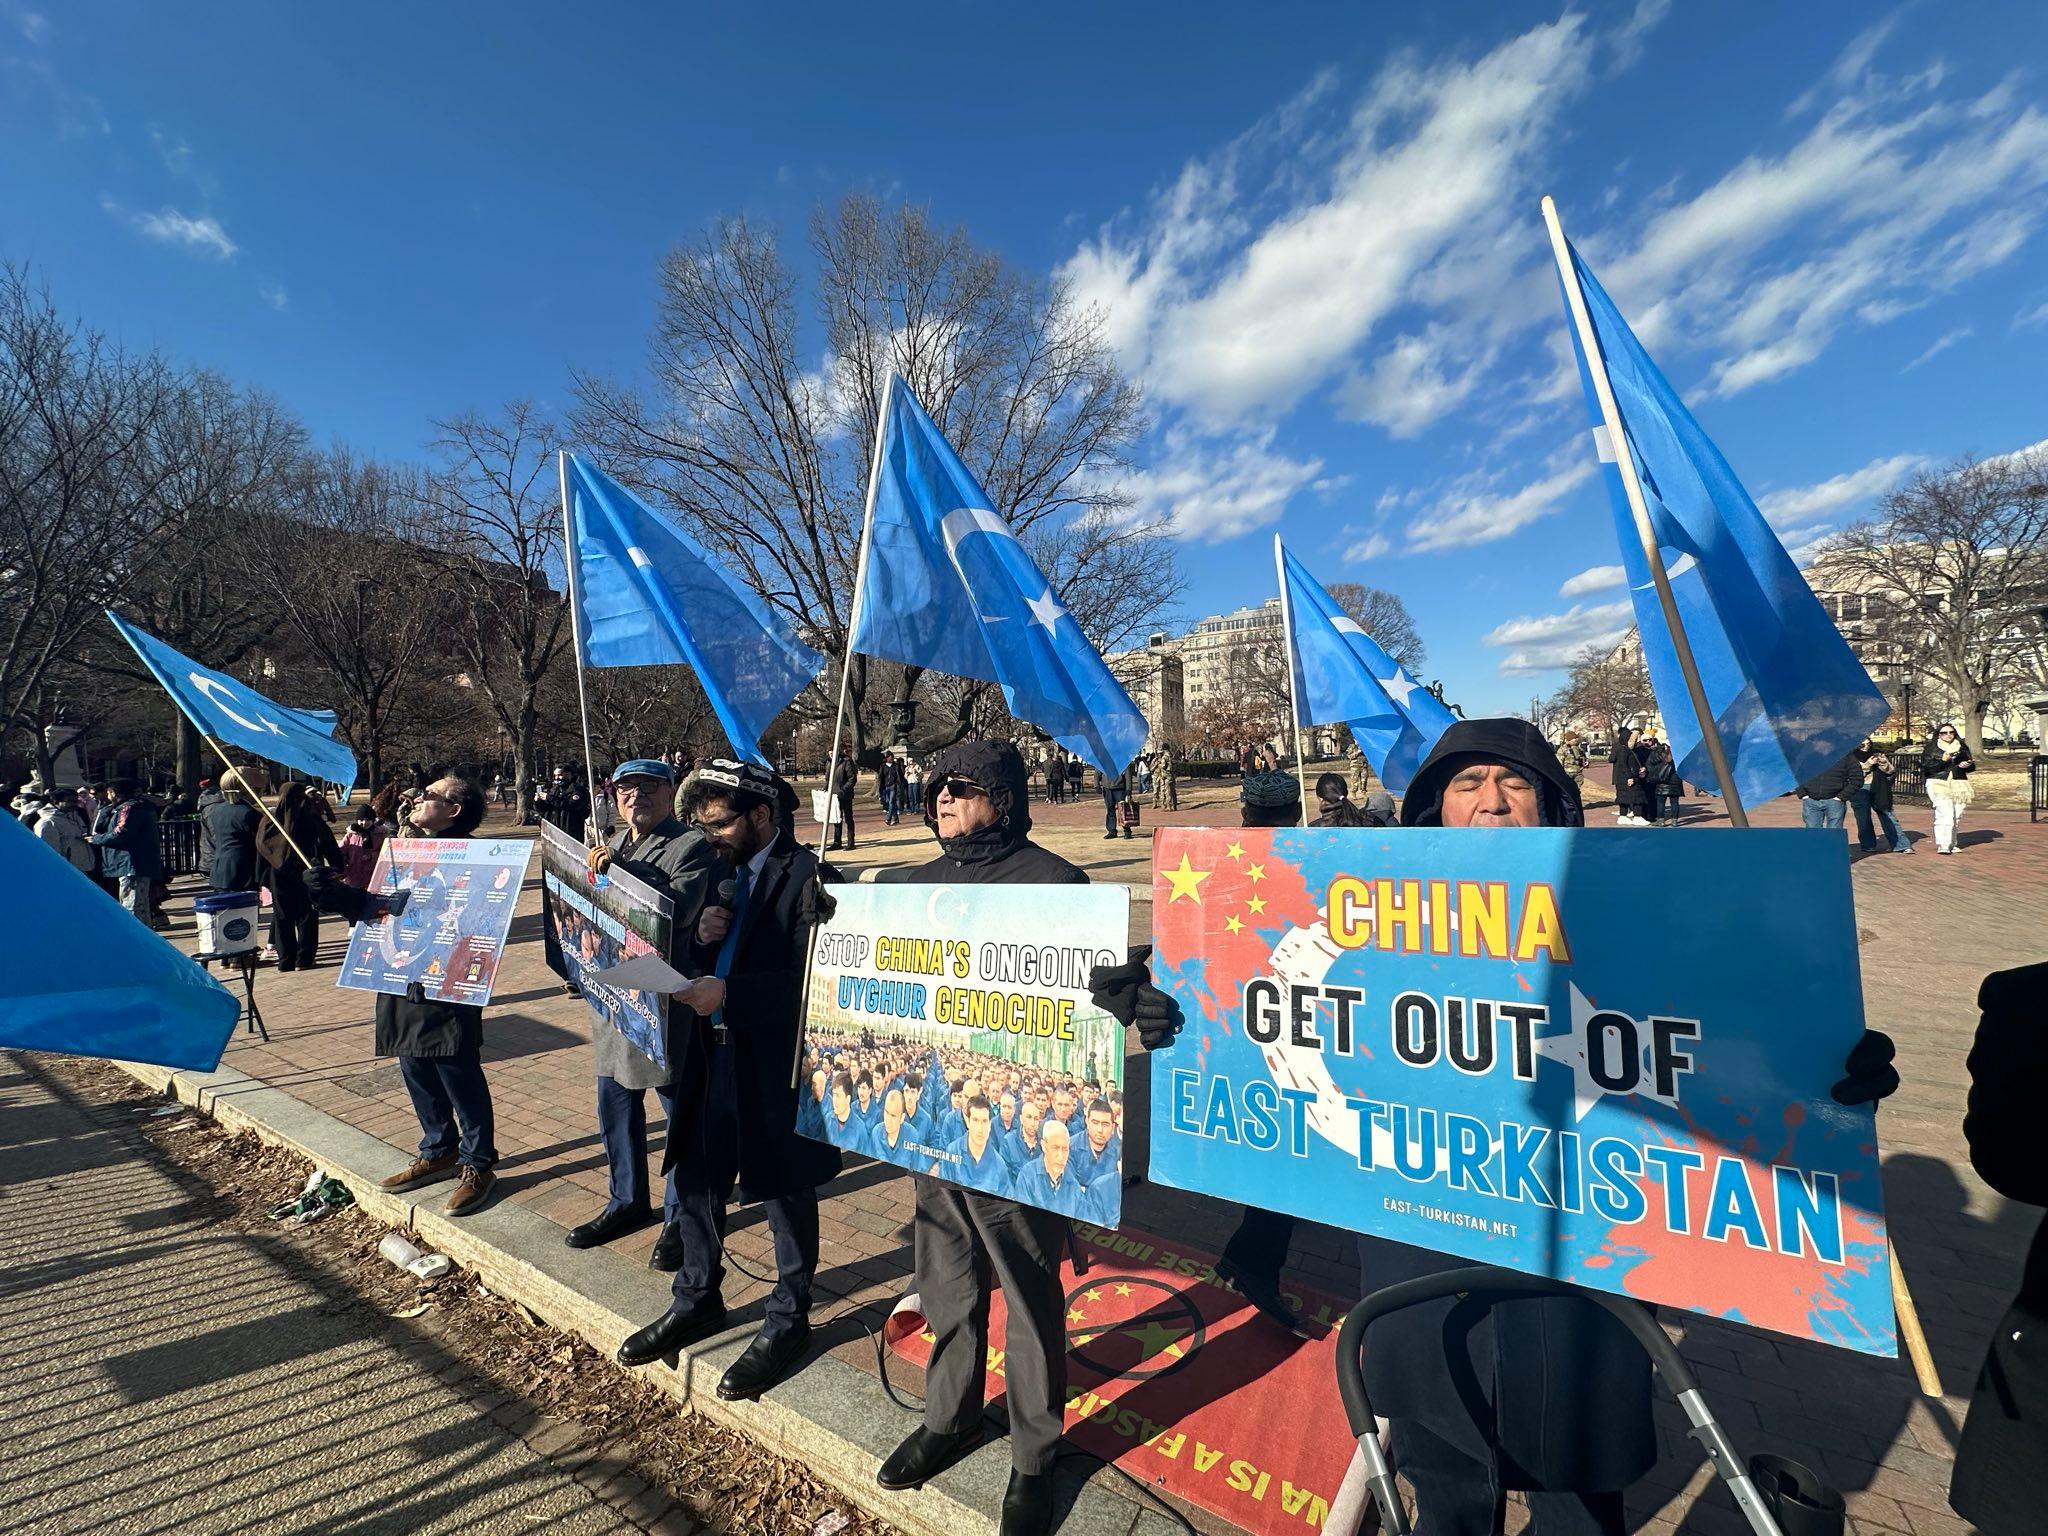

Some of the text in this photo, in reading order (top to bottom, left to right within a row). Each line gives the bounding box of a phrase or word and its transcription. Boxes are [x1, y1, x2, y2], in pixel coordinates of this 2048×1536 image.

[1325, 877, 1573, 964] CHINA
[817, 933, 869, 968] STOP
[875, 936, 970, 978] CHINA'S
[588, 978, 620, 1014] JANUARY
[642, 1005, 658, 1029] Day
[838, 975, 1075, 1041] UYGHUR GENOCIDE
[1242, 976, 1701, 1101] GET OUT OF
[903, 1140, 963, 1165] EAST-TURKISTAN.NET
[1172, 1067, 1846, 1266] EAST TURKISTAN
[1383, 1197, 1517, 1238] EAST-TURKISTAN.NET
[1065, 1385, 1187, 1459] FASCIS
[1193, 1441, 1224, 1473] A
[1225, 1460, 1271, 1501] IS
